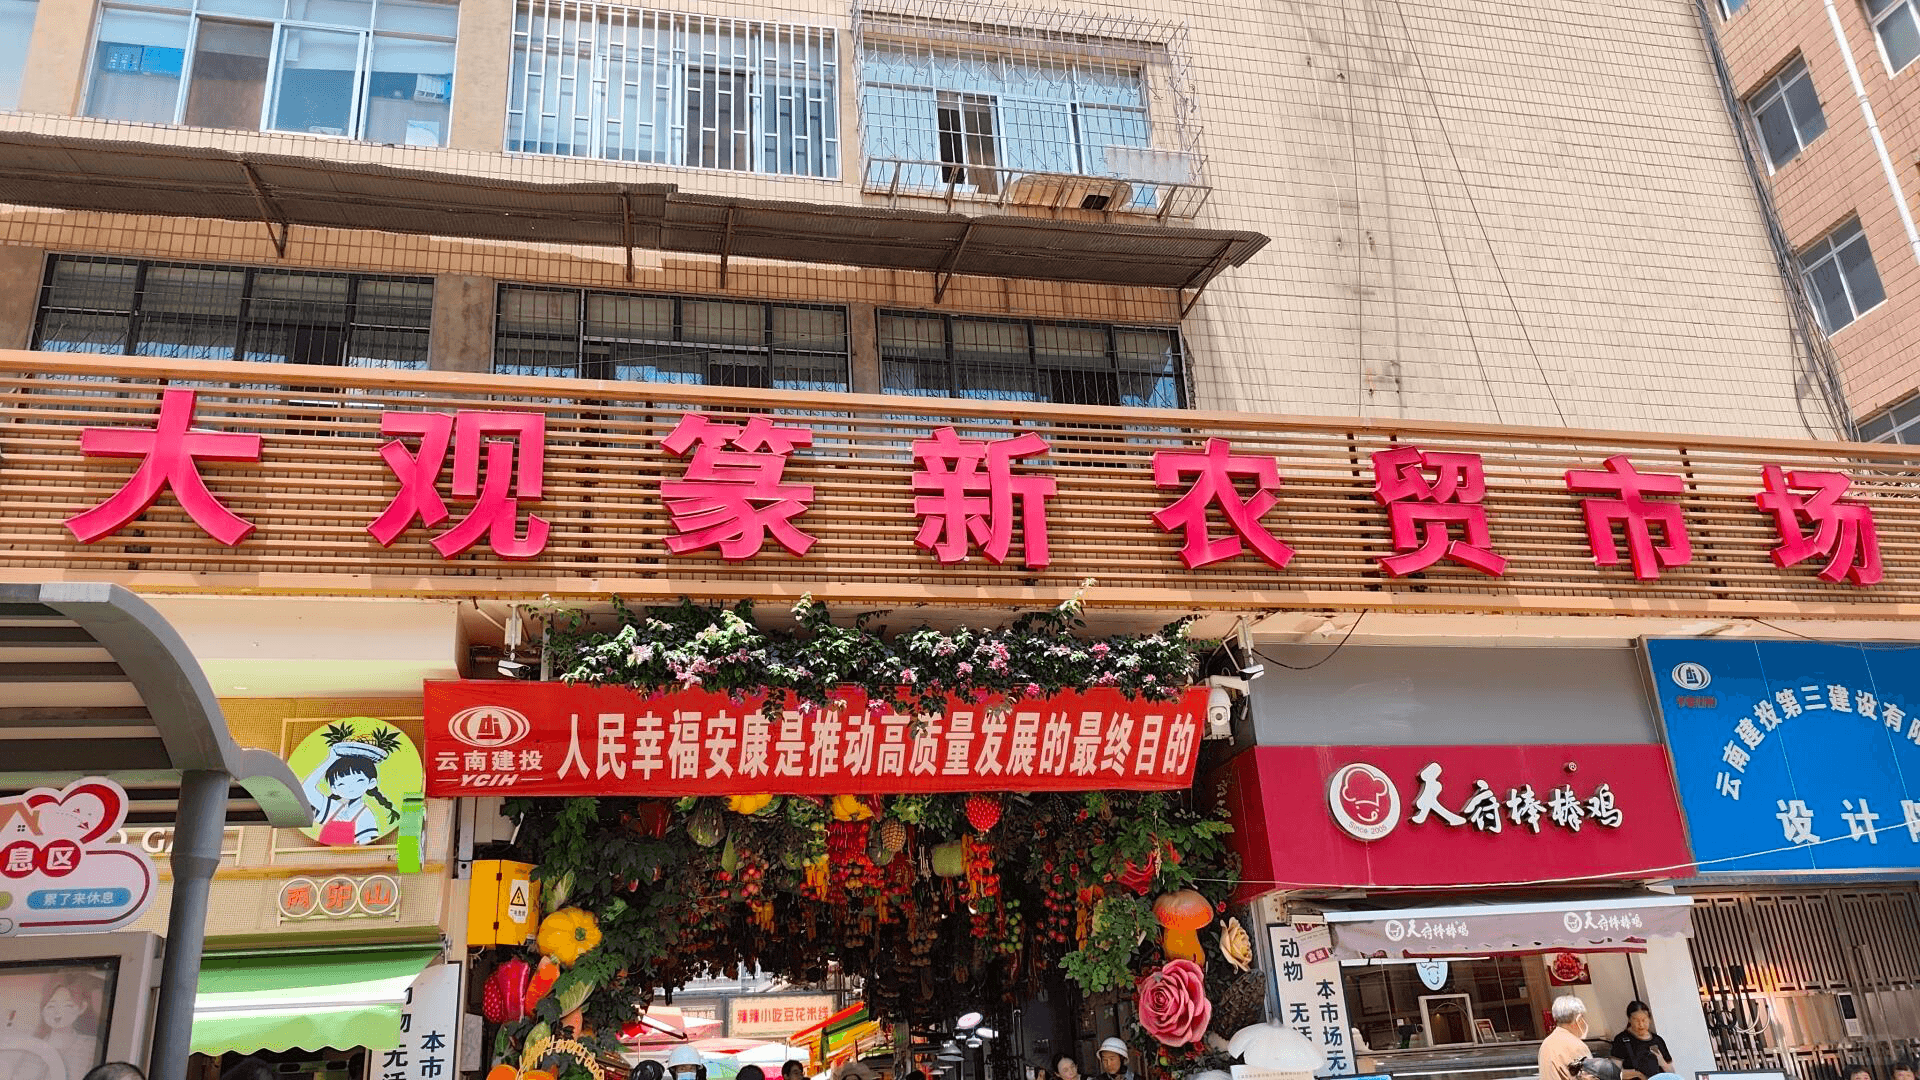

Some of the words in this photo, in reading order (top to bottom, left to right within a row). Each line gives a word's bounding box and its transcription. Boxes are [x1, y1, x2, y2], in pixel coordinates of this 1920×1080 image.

[65, 389, 1884, 588] 大观篆新农贸市场
[557, 709, 1196, 780] 人民幸福安康是推动高质量发展的最终目的
[435, 750, 543, 771] 云南建投
[460, 774, 519, 787] YCIH
[1411, 761, 1624, 835] 天府棒棒鸡
[1348, 820, 1368, 834] Since
[1370, 824, 1388, 835] 2005
[142, 828, 173, 853] G
[5, 846, 75, 872] 息区
[43, 891, 114, 906] 累了来休息
[1315, 978, 1347, 1079] 本市场无
